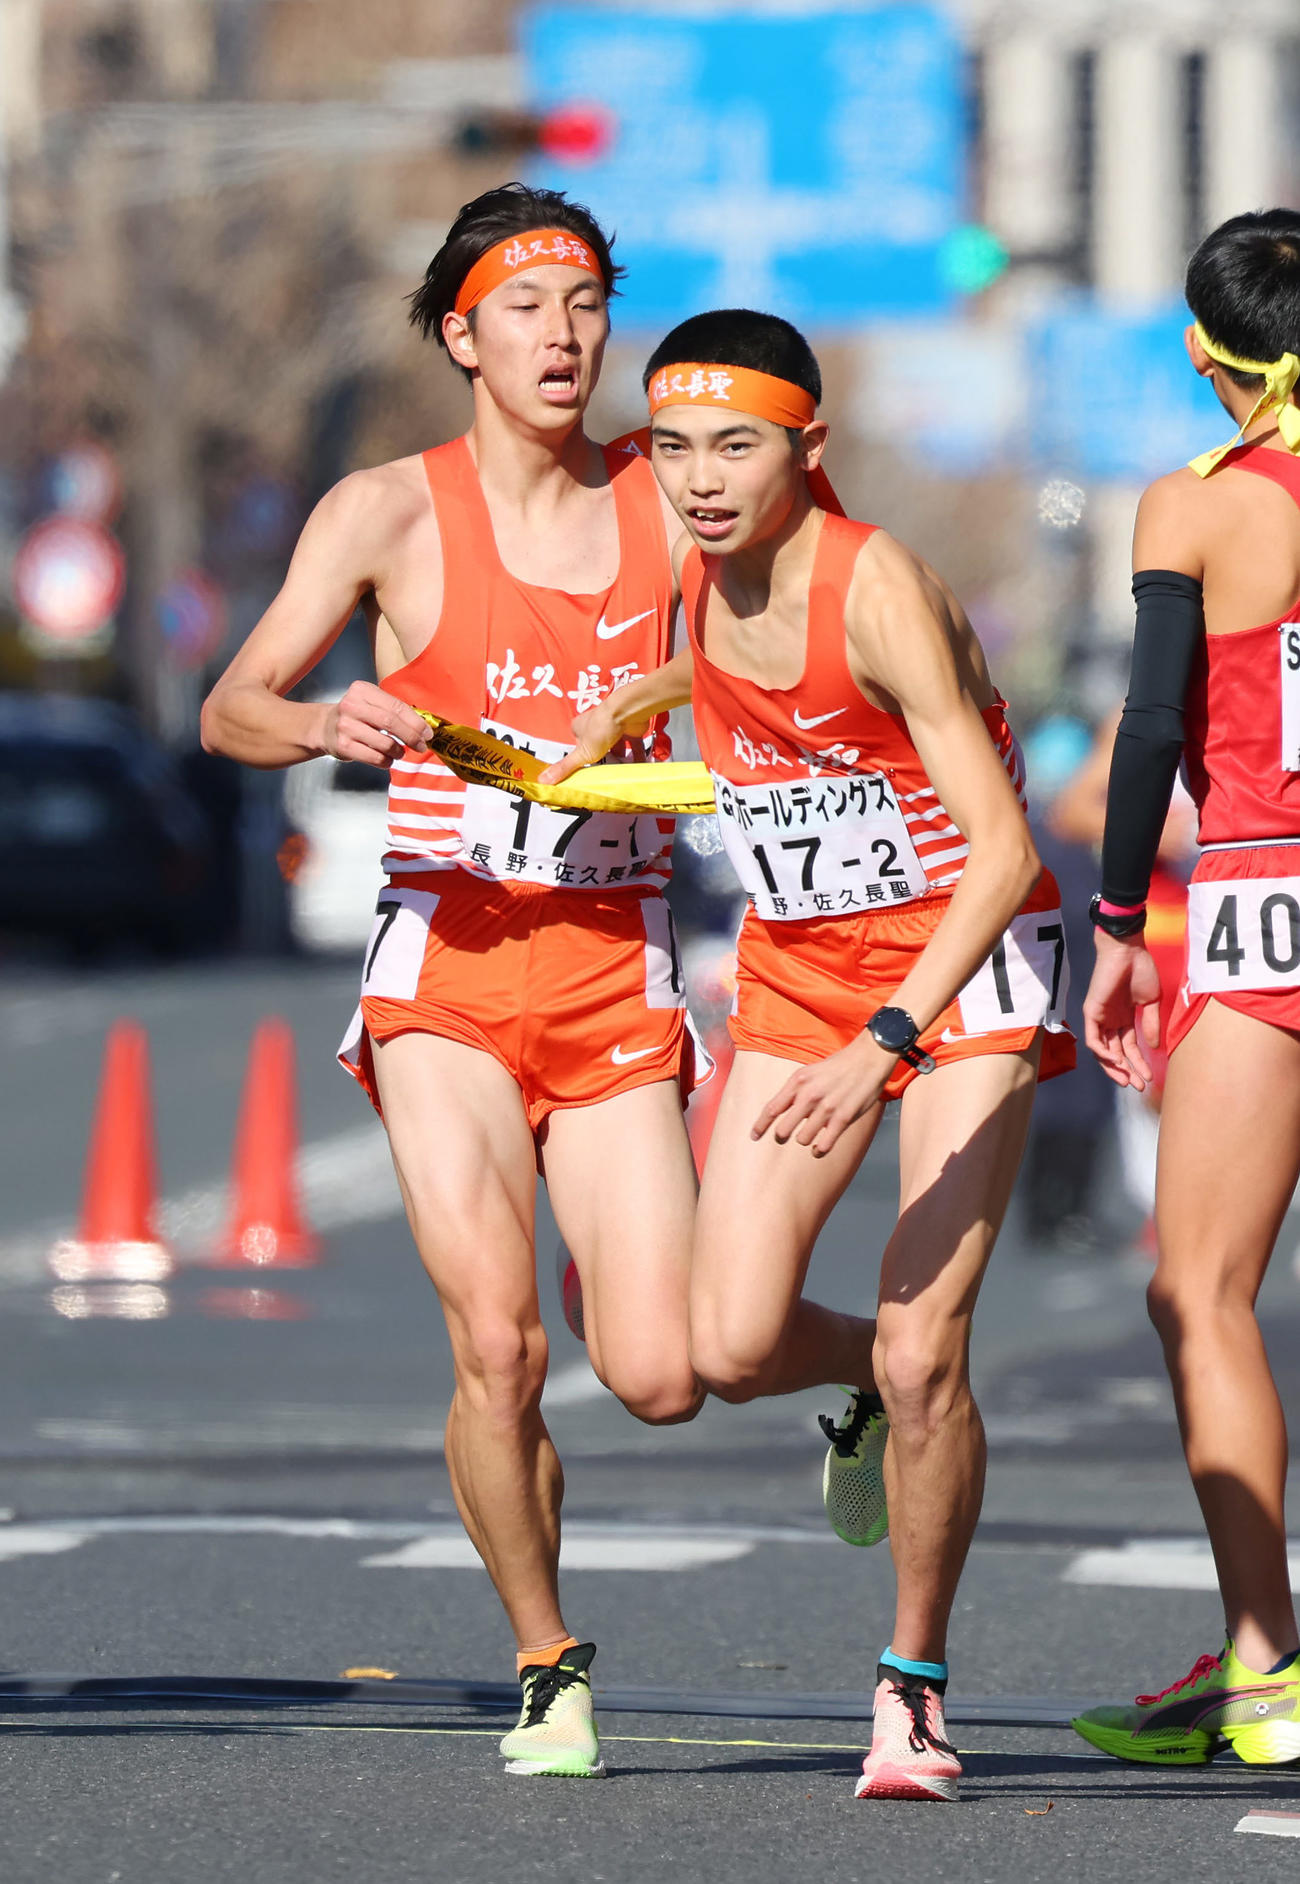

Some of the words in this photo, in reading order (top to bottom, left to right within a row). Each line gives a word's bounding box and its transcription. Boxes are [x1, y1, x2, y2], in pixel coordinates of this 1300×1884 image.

[504, 236, 590, 269] 佐久長聖
[653, 369, 734, 404] 佐久長聖
[1206, 892, 1300, 977] 40
